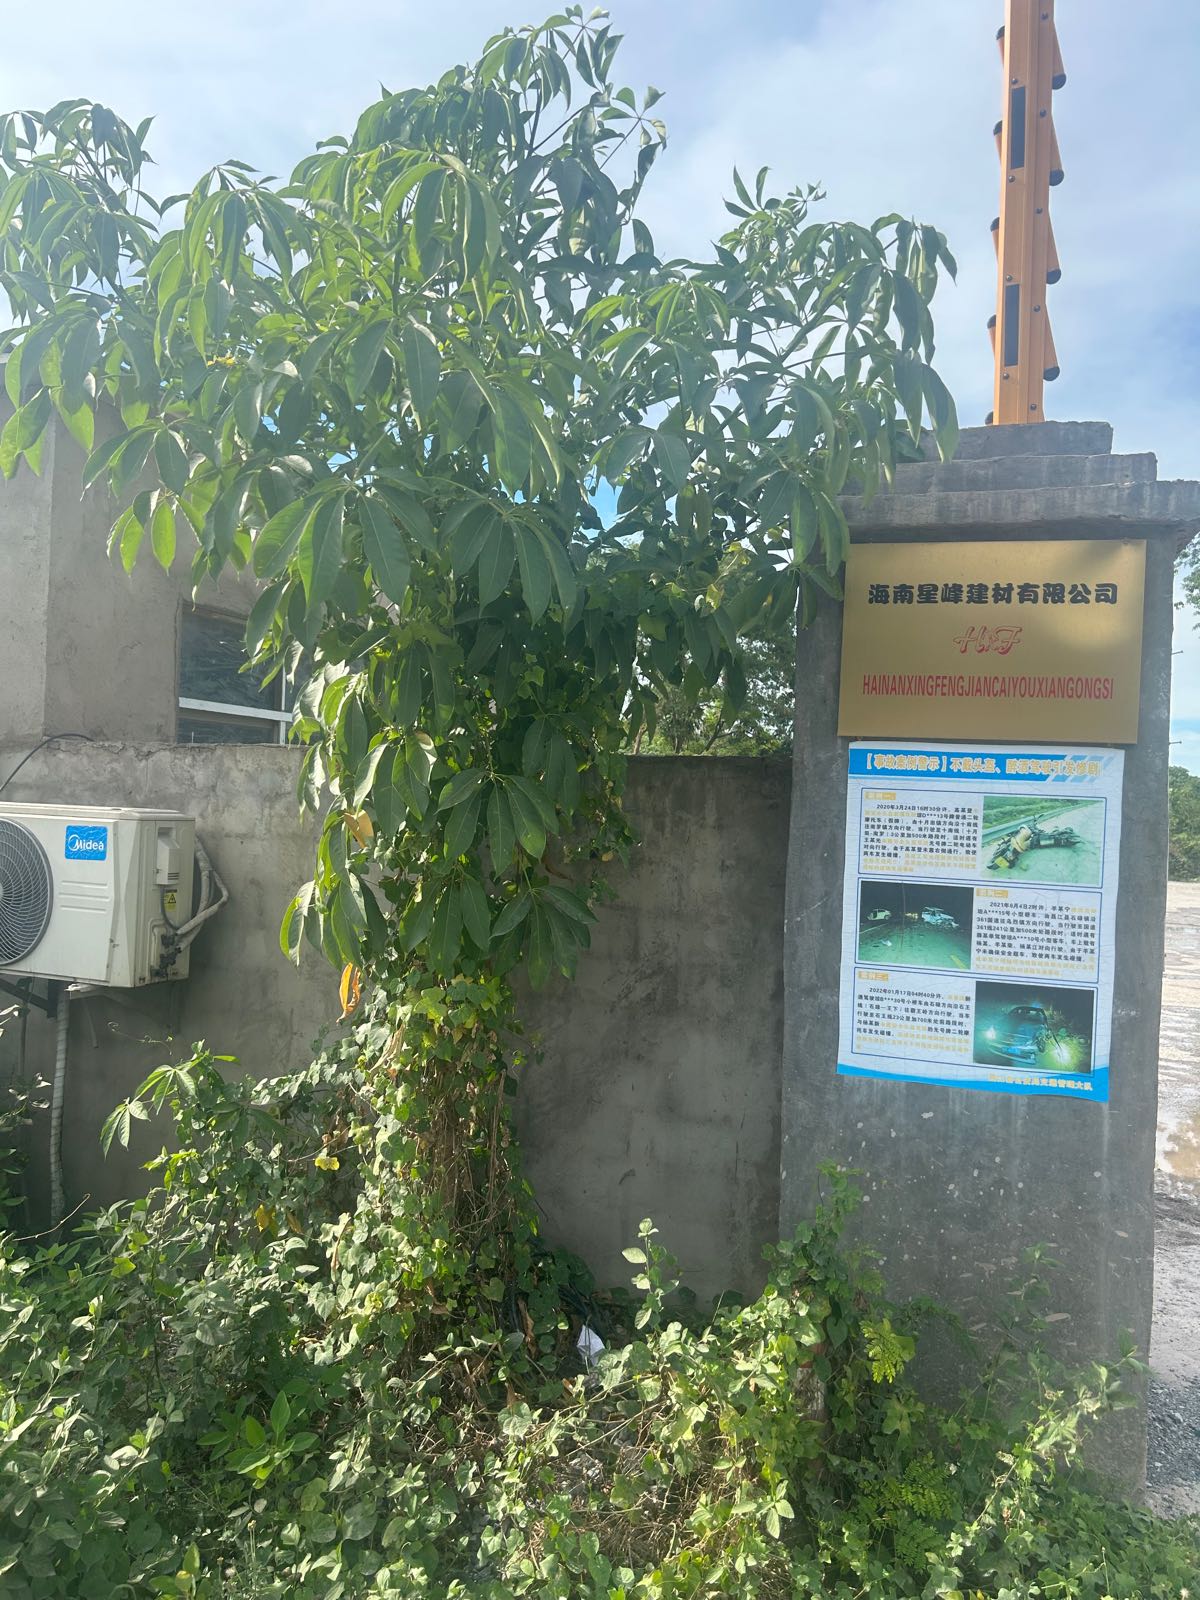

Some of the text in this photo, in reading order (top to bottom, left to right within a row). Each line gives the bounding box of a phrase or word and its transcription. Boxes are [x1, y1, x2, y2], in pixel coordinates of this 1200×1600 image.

[867, 582, 1119, 605] 海南星峰建材有限公司
[862, 674, 1114, 700] HAINANXINGFENGJIANCAIYOUXIANGONGSI
[68, 834, 104, 852] Midea
